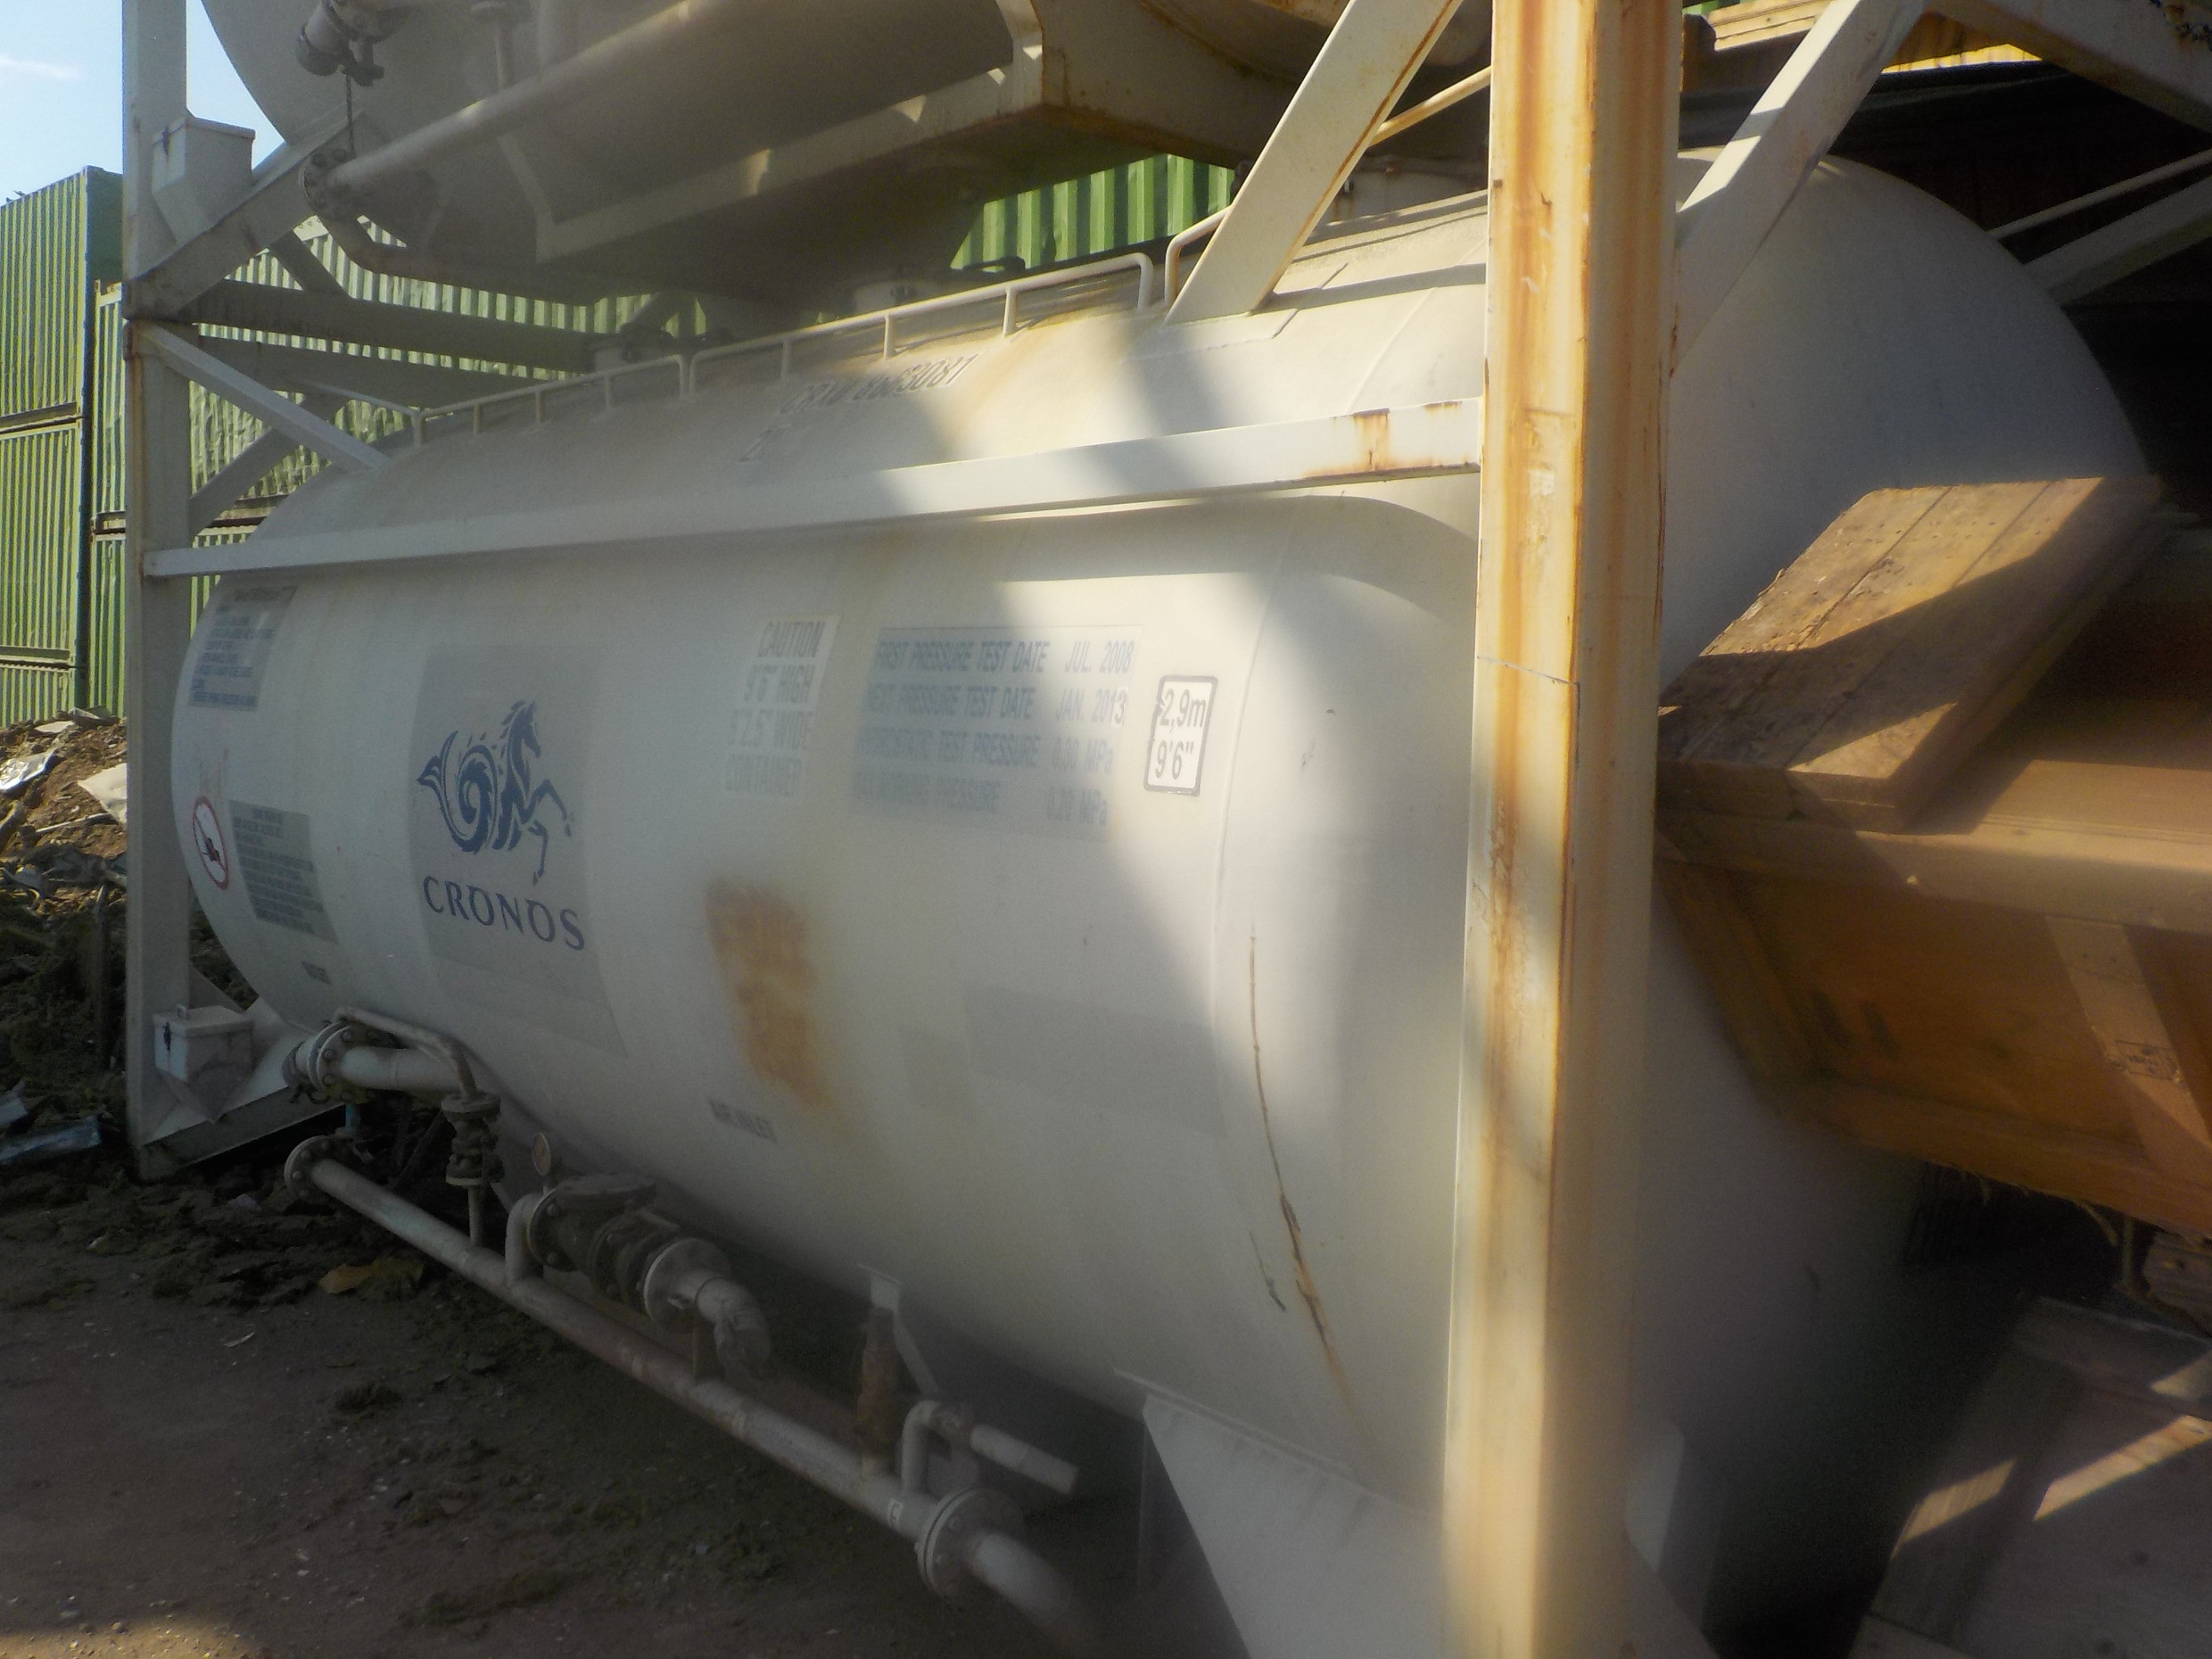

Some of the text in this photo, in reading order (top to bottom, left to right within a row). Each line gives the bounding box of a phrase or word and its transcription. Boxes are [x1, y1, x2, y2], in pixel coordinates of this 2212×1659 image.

[758, 621, 826, 658] CAUTION
[873, 640, 1135, 676] FIRST PRESSURE TEST DATE JUL. 2008
[777, 665, 815, 704] HIGH
[896, 683, 962, 718] PRESSURE
[964, 685, 999, 719] TEST
[999, 686, 1036, 721] DATE
[1054, 688, 1085, 722] JAN.
[1091, 689, 1127, 726] 2013
[1160, 688, 1207, 733] 2,9m
[937, 729, 974, 764] TEST
[970, 731, 1041, 770] PRESSURE
[1085, 739, 1114, 775] MPa
[1154, 739, 1194, 780] 9'6"
[1077, 788, 1108, 826] MPa
[423, 875, 586, 953] CRONOS
